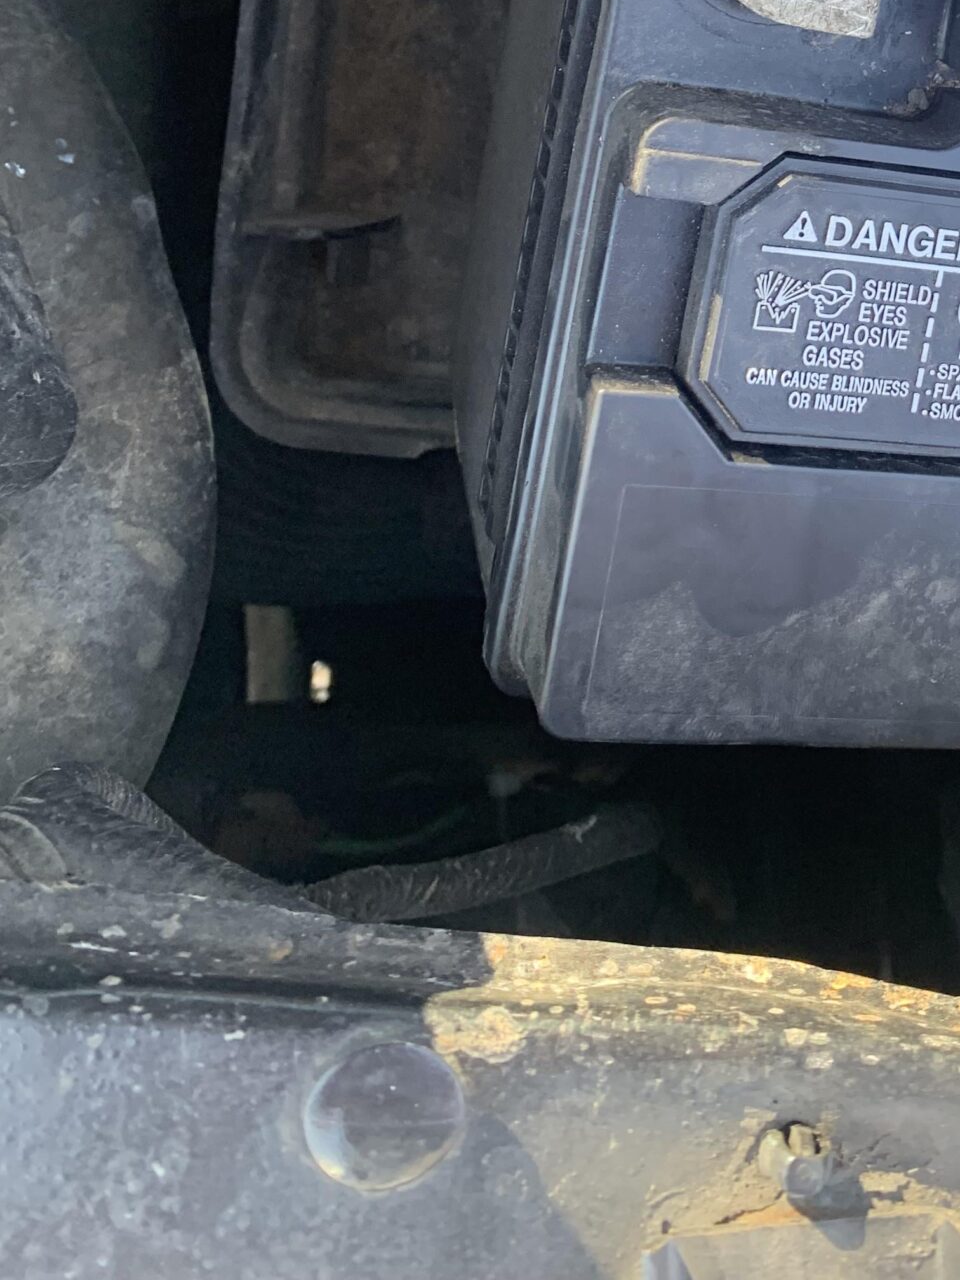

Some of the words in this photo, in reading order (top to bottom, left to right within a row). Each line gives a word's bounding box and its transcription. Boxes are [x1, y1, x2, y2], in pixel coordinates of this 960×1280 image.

[863, 280, 931, 305] SHIELD
[859, 303, 907, 326] EYES
[807, 321, 910, 349] EXPLOSIVE
[803, 345, 864, 370] GASES
[746, 368, 777, 386] CAN
[781, 371, 829, 390] CAUSE
[831, 375, 909, 396] BLINDNESS
[789, 392, 811, 409] OR
[814, 393, 867, 413] INJURY
